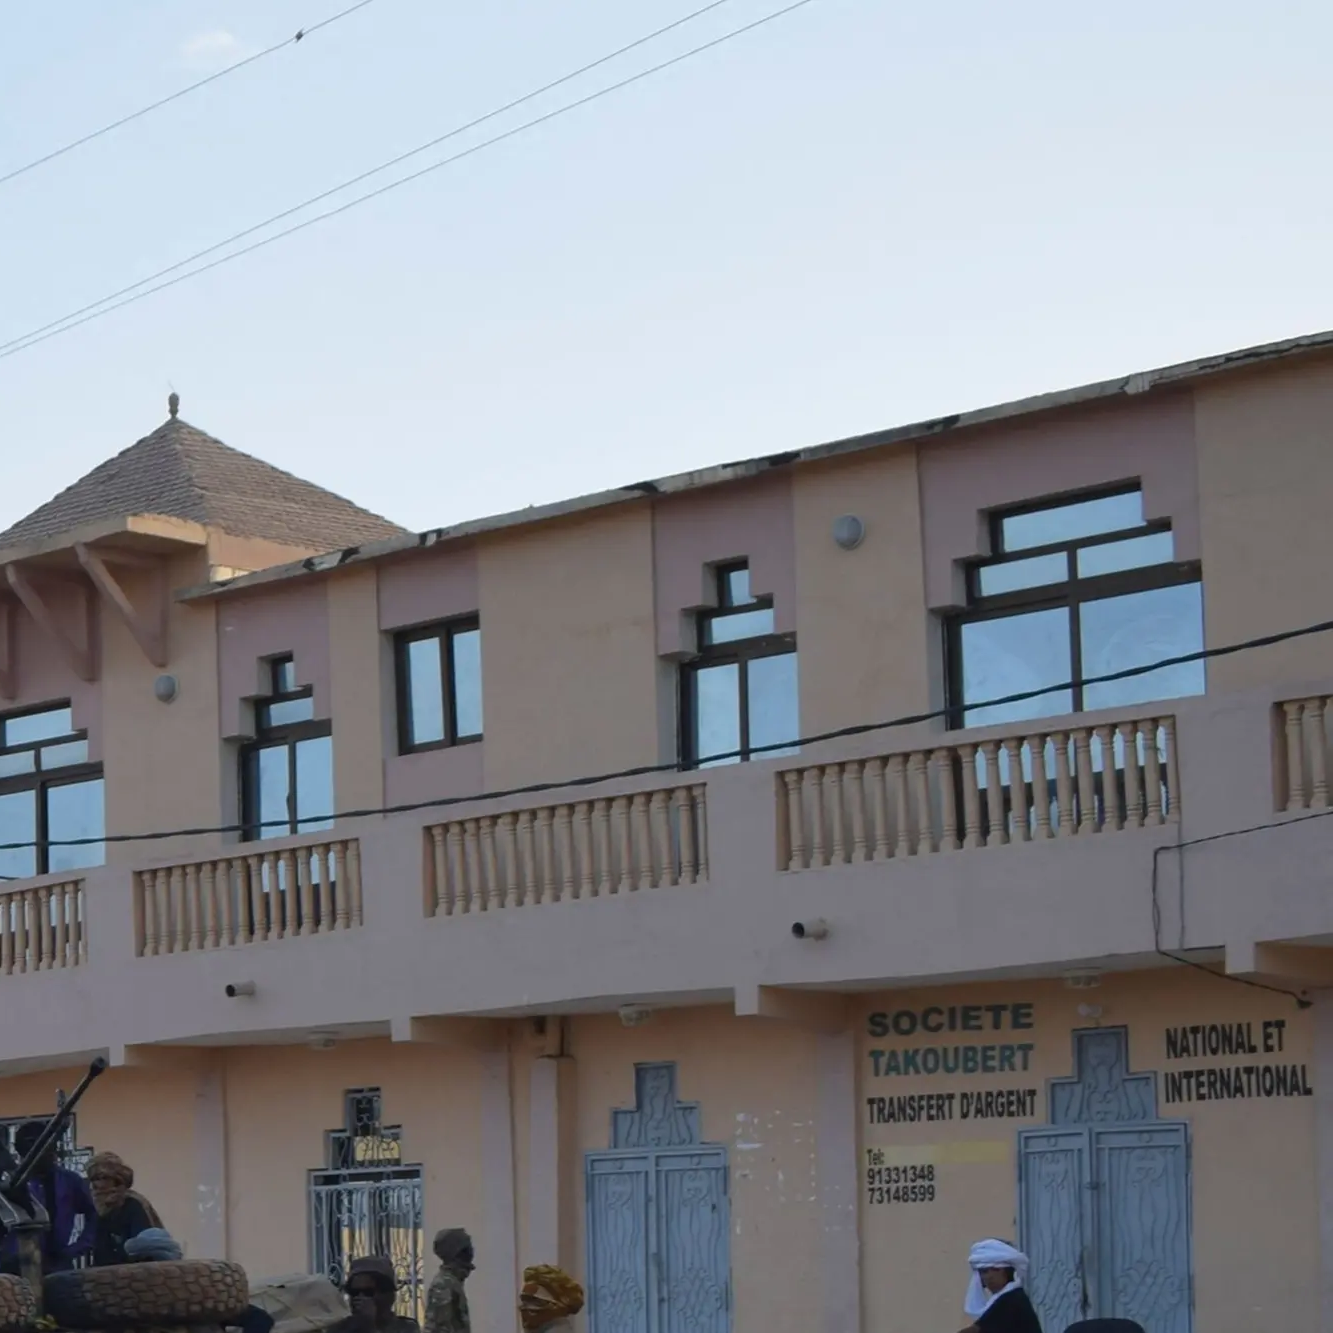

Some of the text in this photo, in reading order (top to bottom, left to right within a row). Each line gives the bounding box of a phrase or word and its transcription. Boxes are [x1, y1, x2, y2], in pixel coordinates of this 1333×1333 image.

[867, 1003, 1034, 1037] SOCIETE
[1165, 1019, 1286, 1059] NATIONAL ET
[869, 1043, 1034, 1077] TAKOUBERT
[1165, 1064, 1313, 1103] INTERNATIONAL
[867, 1089, 1037, 1124] TRANSFERT D'ARGENT
[867, 1164, 935, 1185] 91331348
[868, 1184, 936, 1204] 73148599
